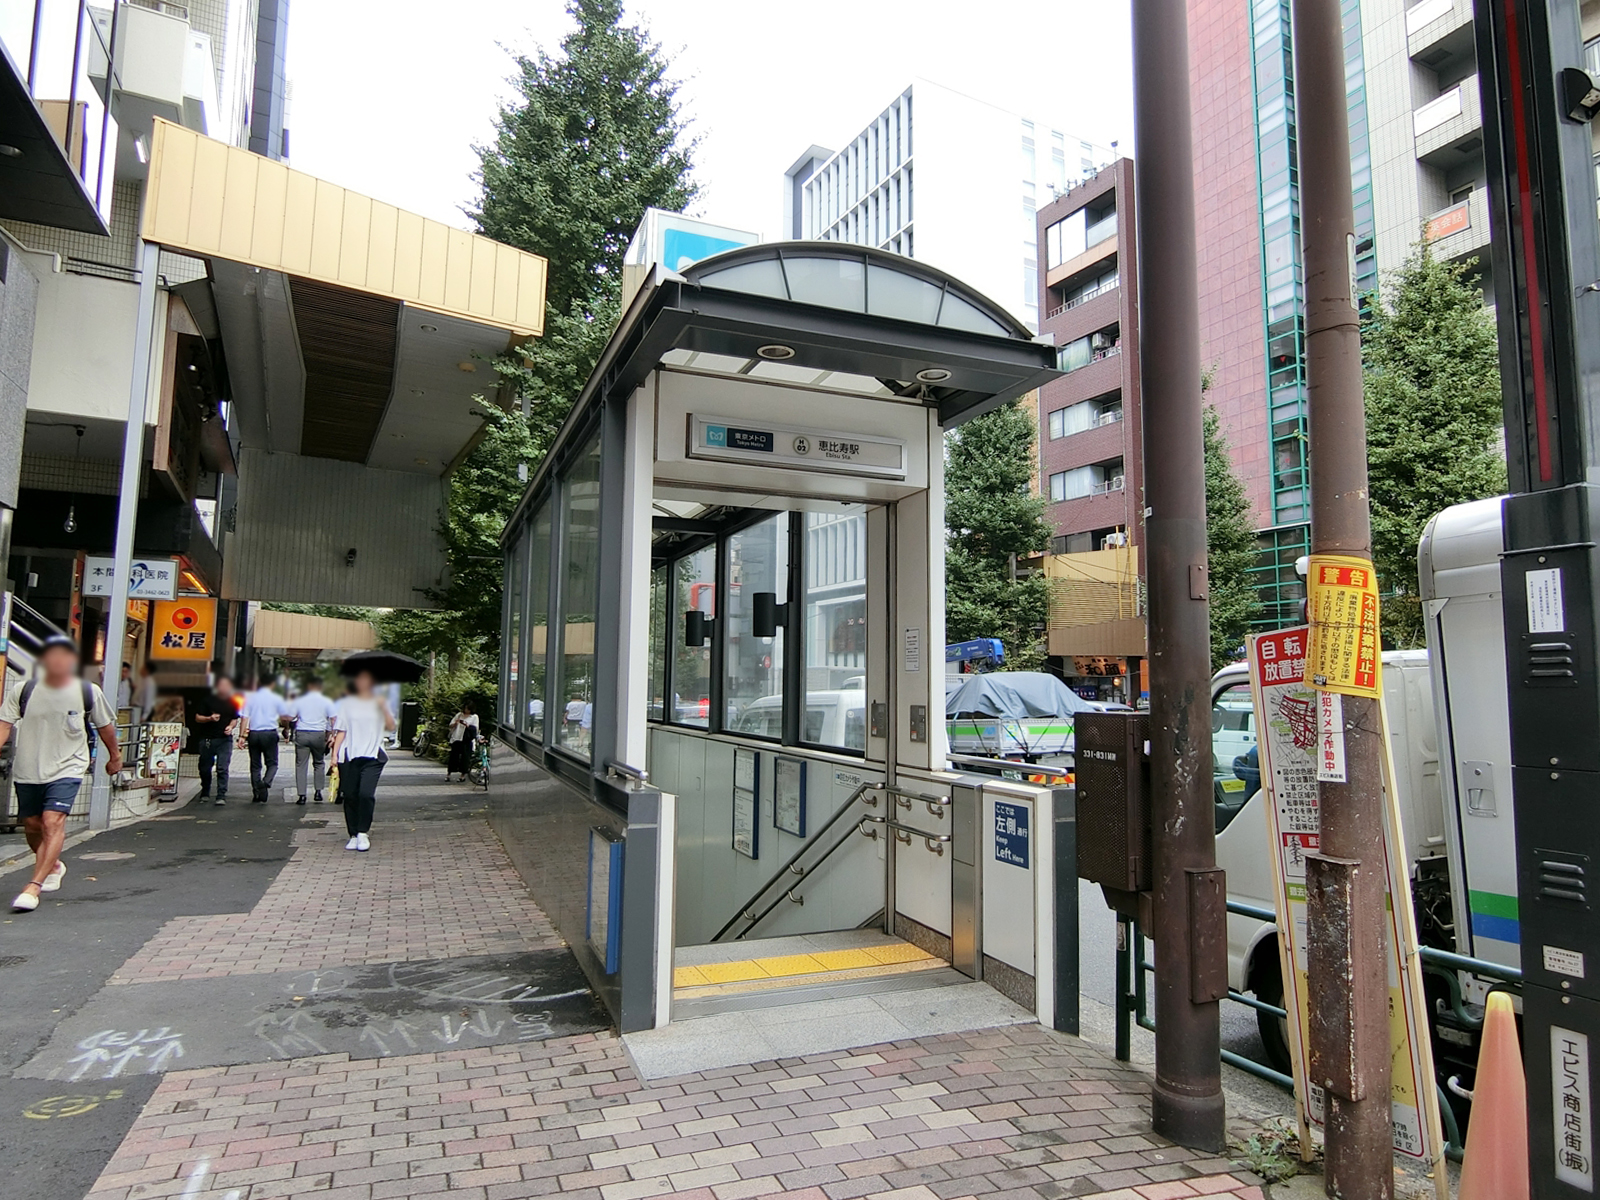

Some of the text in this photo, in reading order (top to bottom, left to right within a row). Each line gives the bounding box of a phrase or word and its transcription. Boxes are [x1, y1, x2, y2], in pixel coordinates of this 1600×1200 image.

[735, 432, 766, 443] 東京メトロ
[818, 440, 860, 455] 恵比寿駅
[1323, 567, 1364, 586] 警告
[91, 584, 103, 593] 3F
[161, 632, 206, 650] 松屋
[996, 804, 1015, 816] ここでは
[996, 835, 1008, 845] Keep
[996, 846, 1024, 864] Left Here
